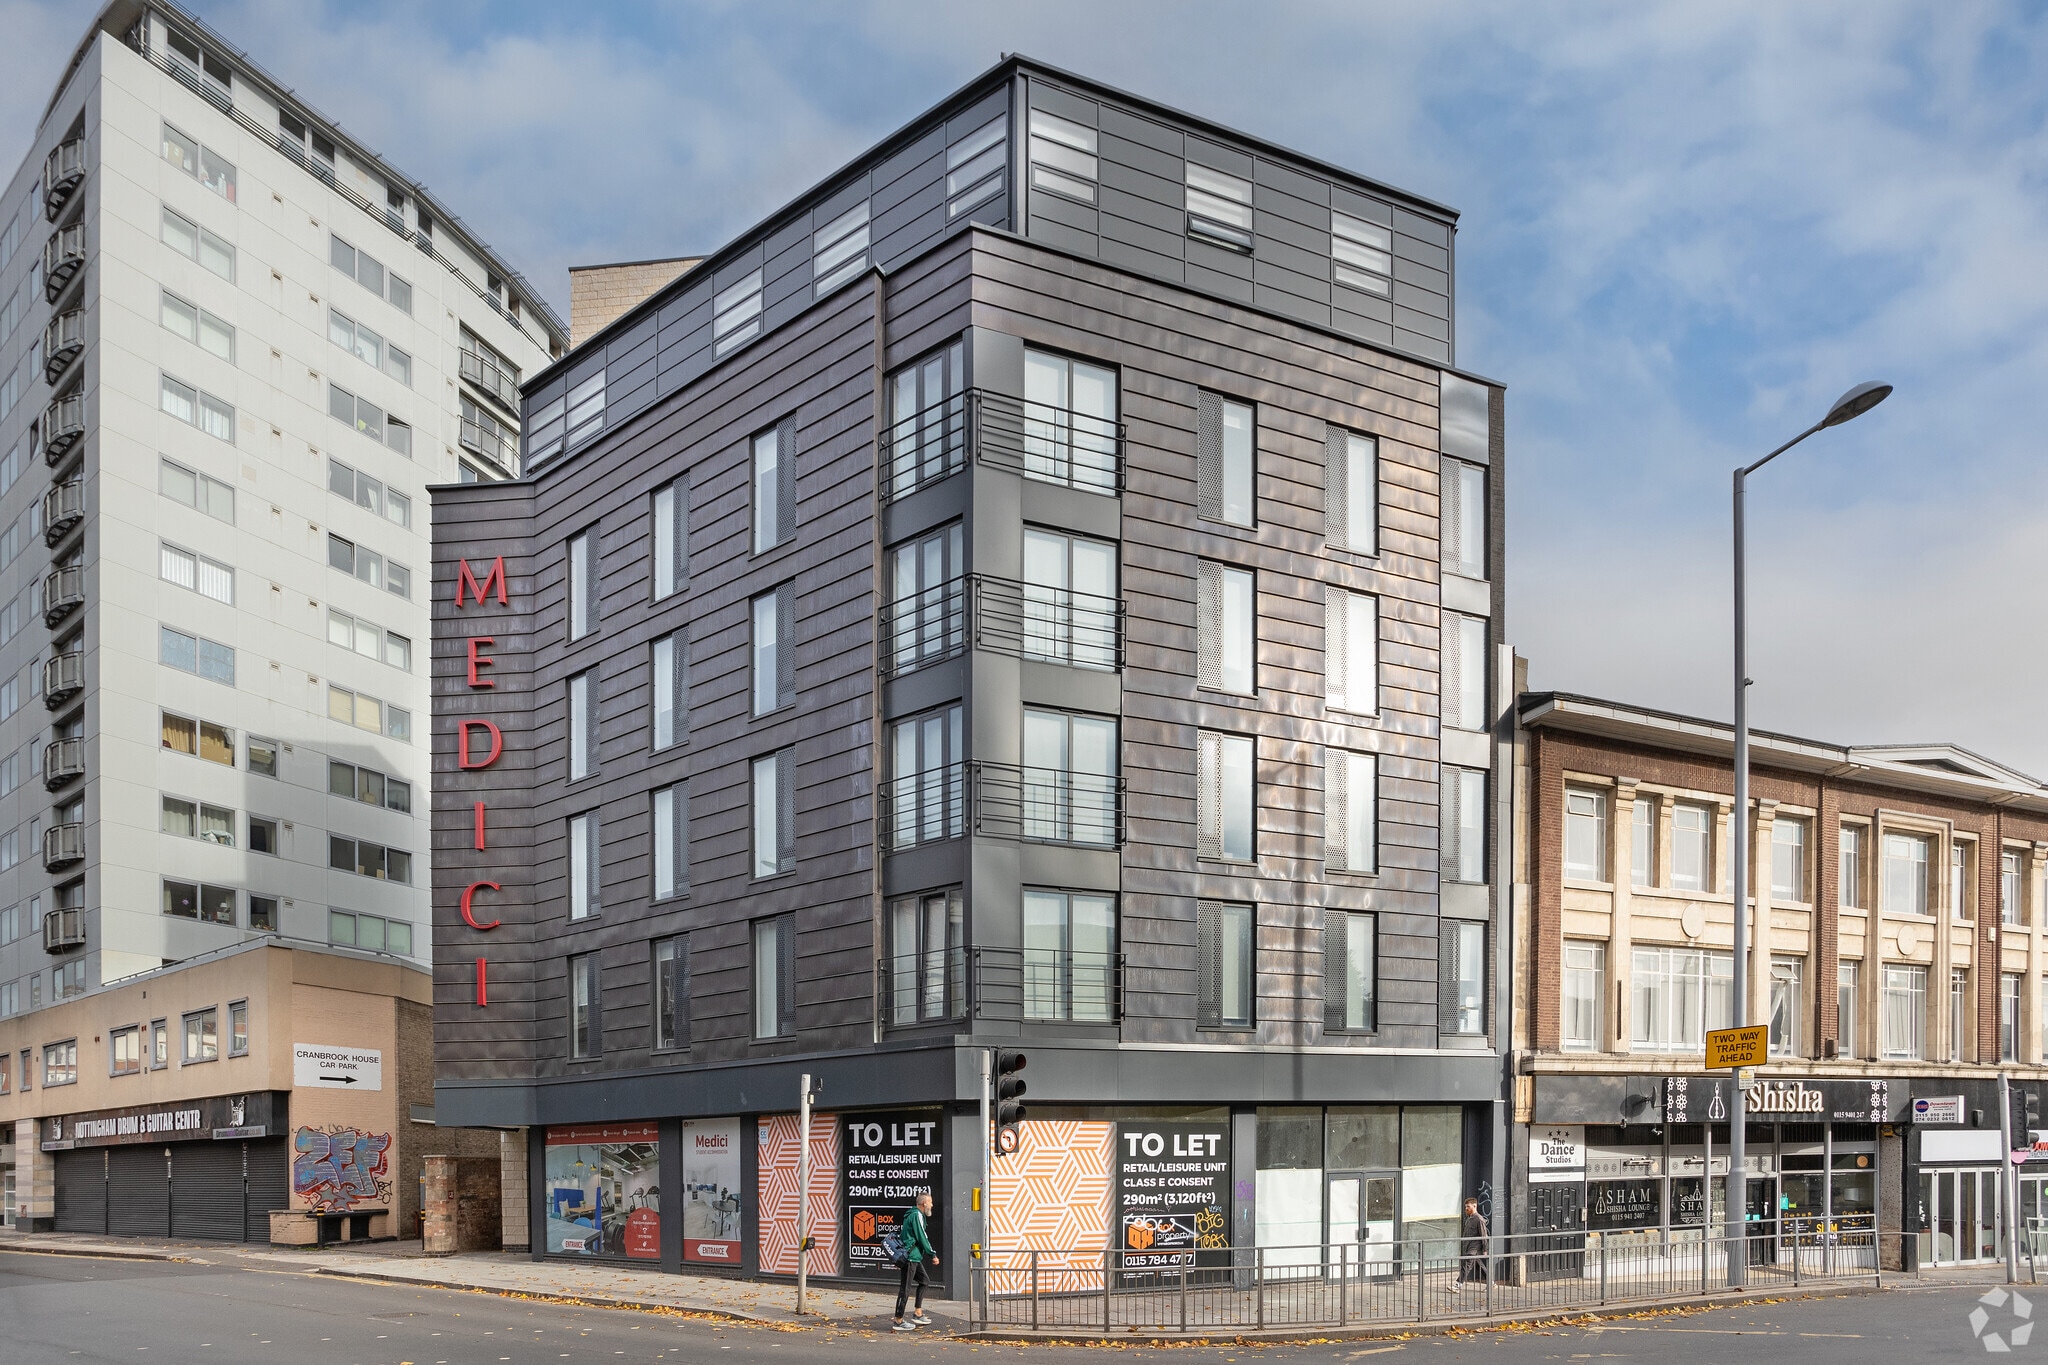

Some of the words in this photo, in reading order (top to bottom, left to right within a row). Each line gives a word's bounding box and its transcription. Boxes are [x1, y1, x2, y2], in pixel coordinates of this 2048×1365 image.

[454, 554, 508, 1007] MEDICI
[1713, 1034, 1735, 1043] TWO
[1740, 1031, 1760, 1041] WAY
[1716, 1042, 1757, 1053] TRAFFIC
[296, 1050, 349, 1061] CRANBROOK
[352, 1055, 379, 1063] HOUSE
[1719, 1052, 1753, 1063] AHEAD
[338, 1062, 358, 1070] PARK
[1748, 1081, 1824, 1113] Shisha
[75, 1119, 117, 1139] NOTTINGHAM
[117, 1116, 139, 1136] DRUM
[140, 1115, 146, 1133] &
[147, 1112, 174, 1133] GUITAR
[175, 1110, 200, 1130] CENTR
[849, 1122, 883, 1147] TO
[891, 1121, 936, 1146] LET
[696, 1134, 728, 1148] Medici
[1124, 1132, 1164, 1157] TO
[1173, 1134, 1221, 1156] LET
[1552, 1138, 1566, 1146] The
[1540, 1142, 1575, 1156] Dance
[848, 1153, 917, 1165] RETAIL/LEISURE
[919, 1153, 942, 1163] UNIT
[1545, 1155, 1572, 1164] Studios
[1123, 1162, 1201, 1173] RETAIL/LEISURE
[1203, 1162, 1227, 1172] UNIT
[848, 1169, 877, 1179] CLASS
[878, 1169, 885, 1179] E
[886, 1169, 930, 1179] CONSENT
[1123, 1178, 1156, 1187] CLASS
[1158, 1178, 1165, 1187] E
[1167, 1177, 1214, 1187] CONSENT
[848, 1185, 882, 1197] 290m²
[1606, 1188, 1651, 1205] SHAM
[1123, 1193, 1163, 1205] 290m²
[1164, 1192, 1216, 1206] (3,120ft²)
[1606, 1204, 1626, 1213] SHISHA
[1628, 1203, 1651, 1212] LOUNGE
[1680, 1201, 1703, 1211] SHA
[877, 1215, 894, 1224] BOX
[1612, 1213, 1624, 1221] 0115
[702, 1246, 725, 1256] ENTRANCE
[851, 1246, 870, 1256] 0115
[1125, 1255, 1147, 1266] 0115
[1148, 1255, 1168, 1265] 784
[1169, 1254, 1193, 1264] 477
